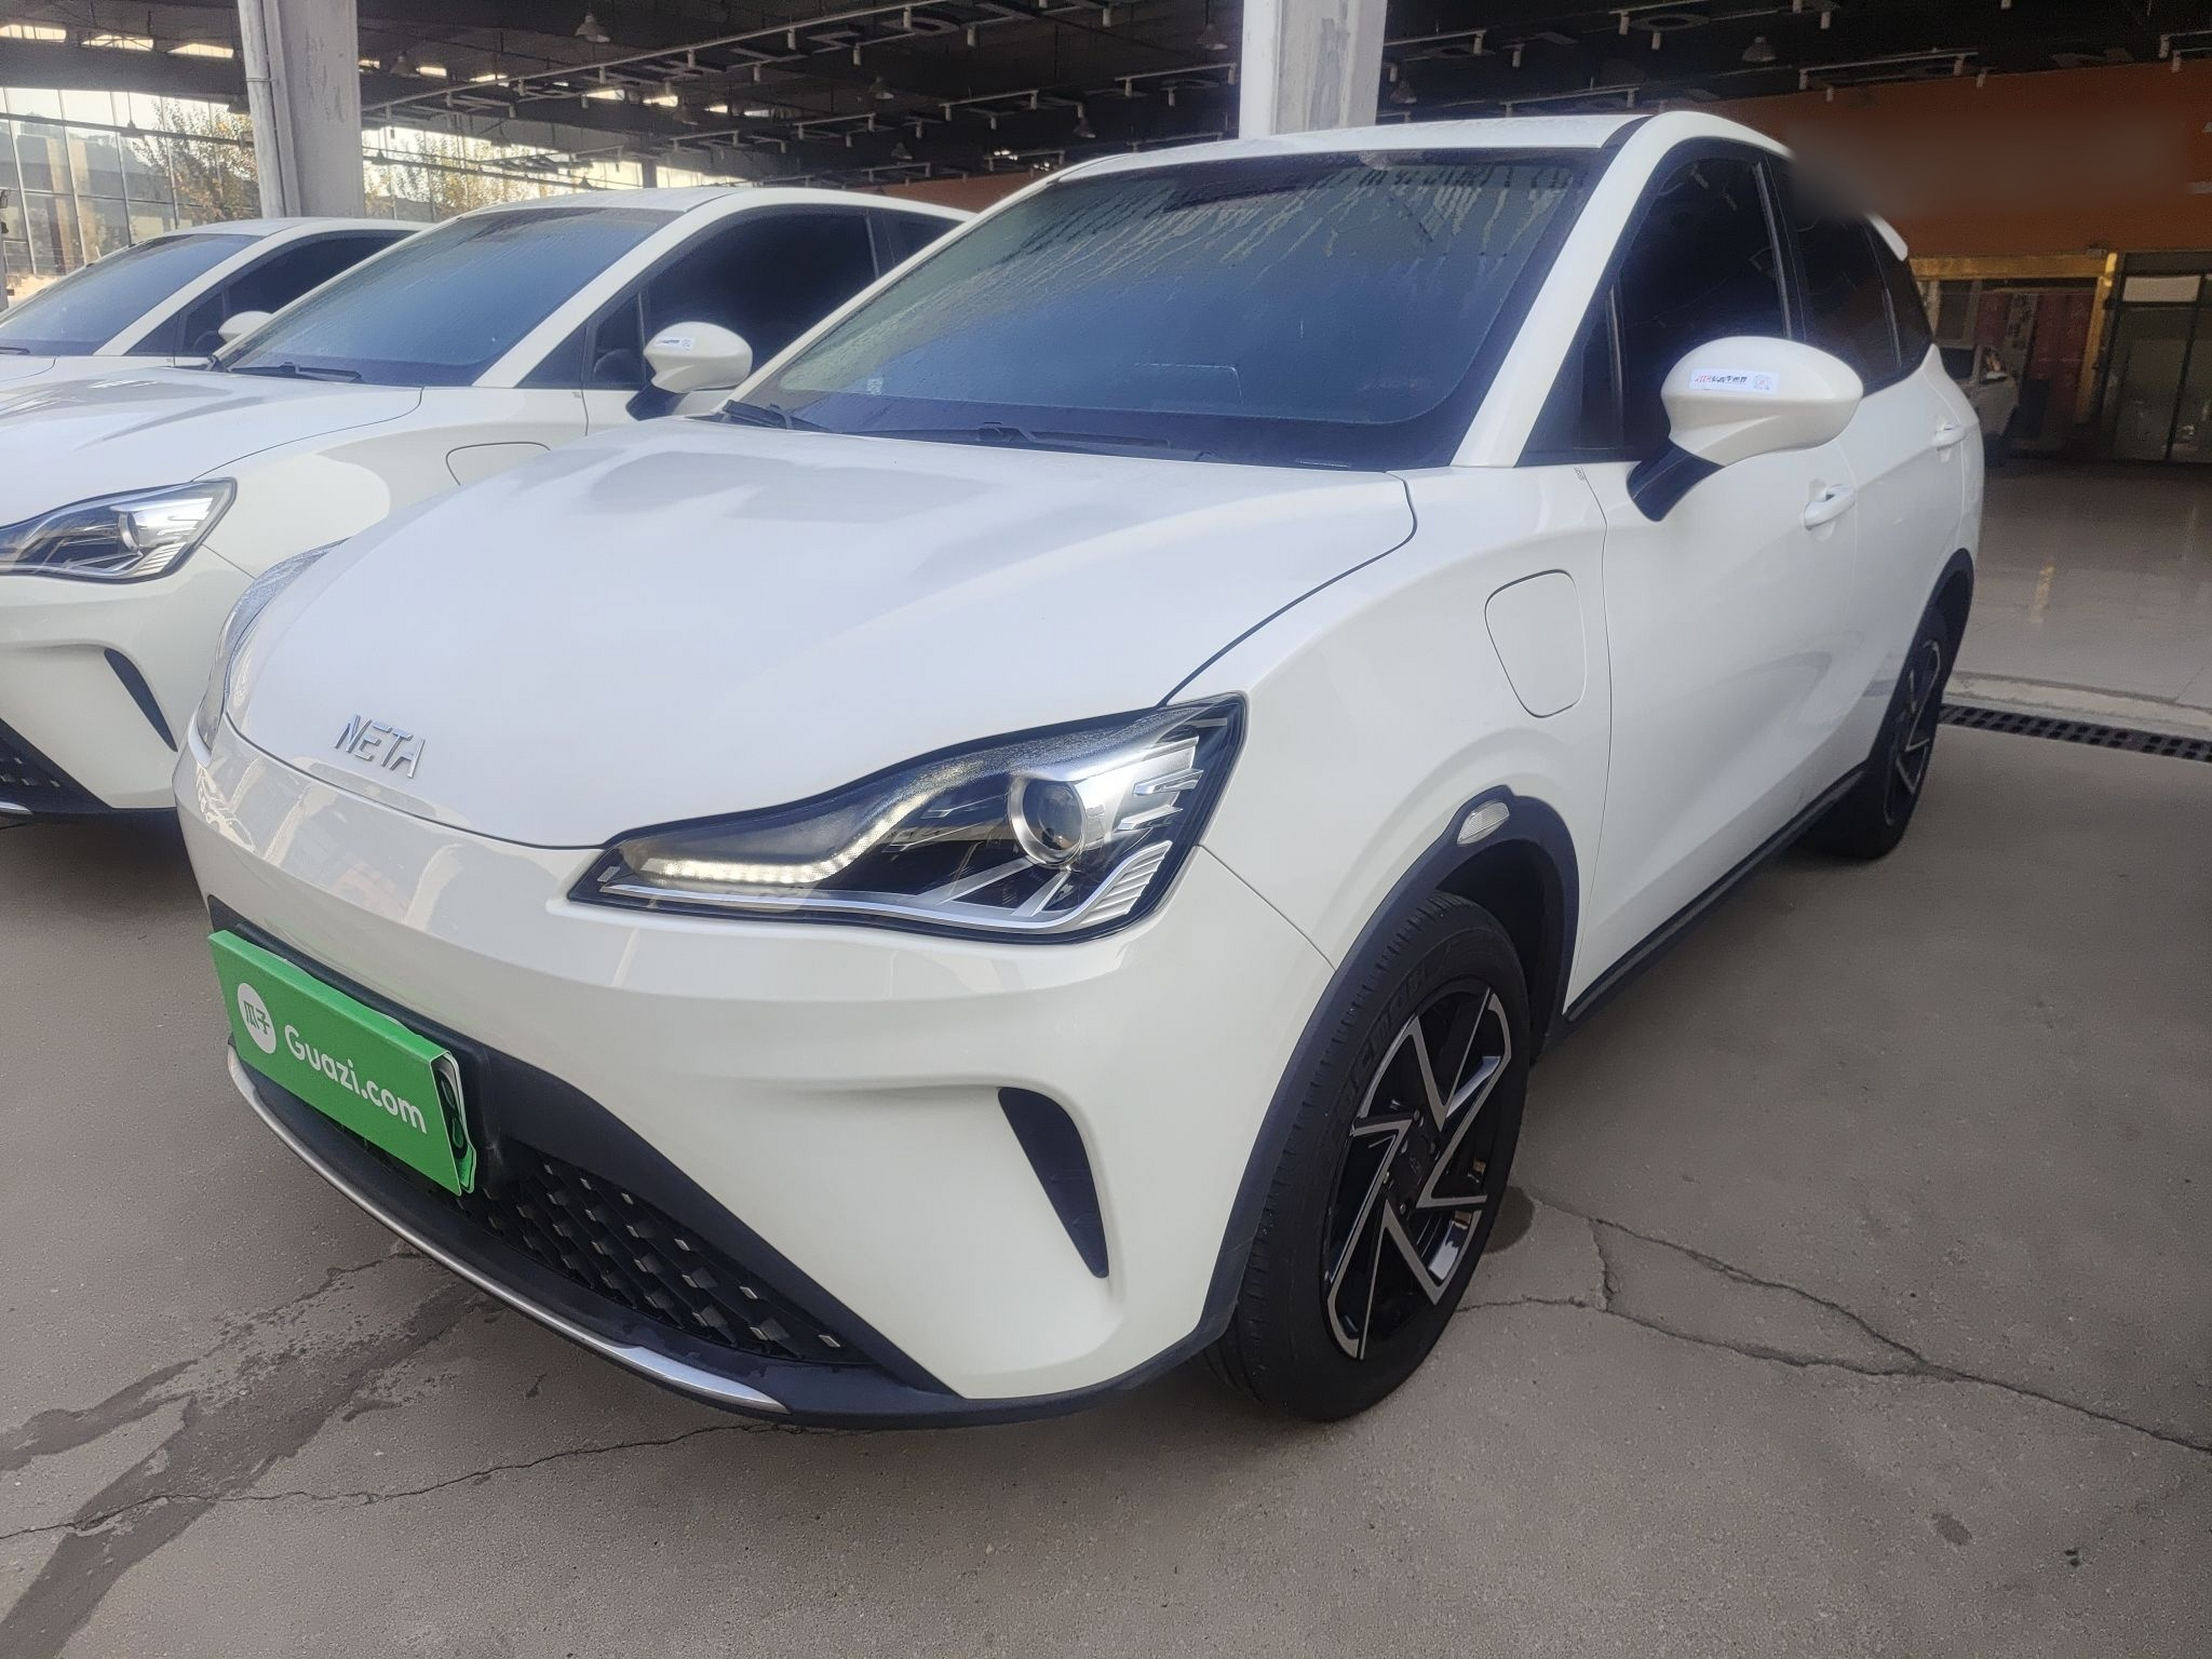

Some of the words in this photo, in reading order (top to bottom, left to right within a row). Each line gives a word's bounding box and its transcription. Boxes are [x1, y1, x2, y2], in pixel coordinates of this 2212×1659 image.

[335, 715, 425, 778] NETA
[243, 1001, 270, 1035] 瓜子
[285, 1024, 427, 1134] Guazi.com
